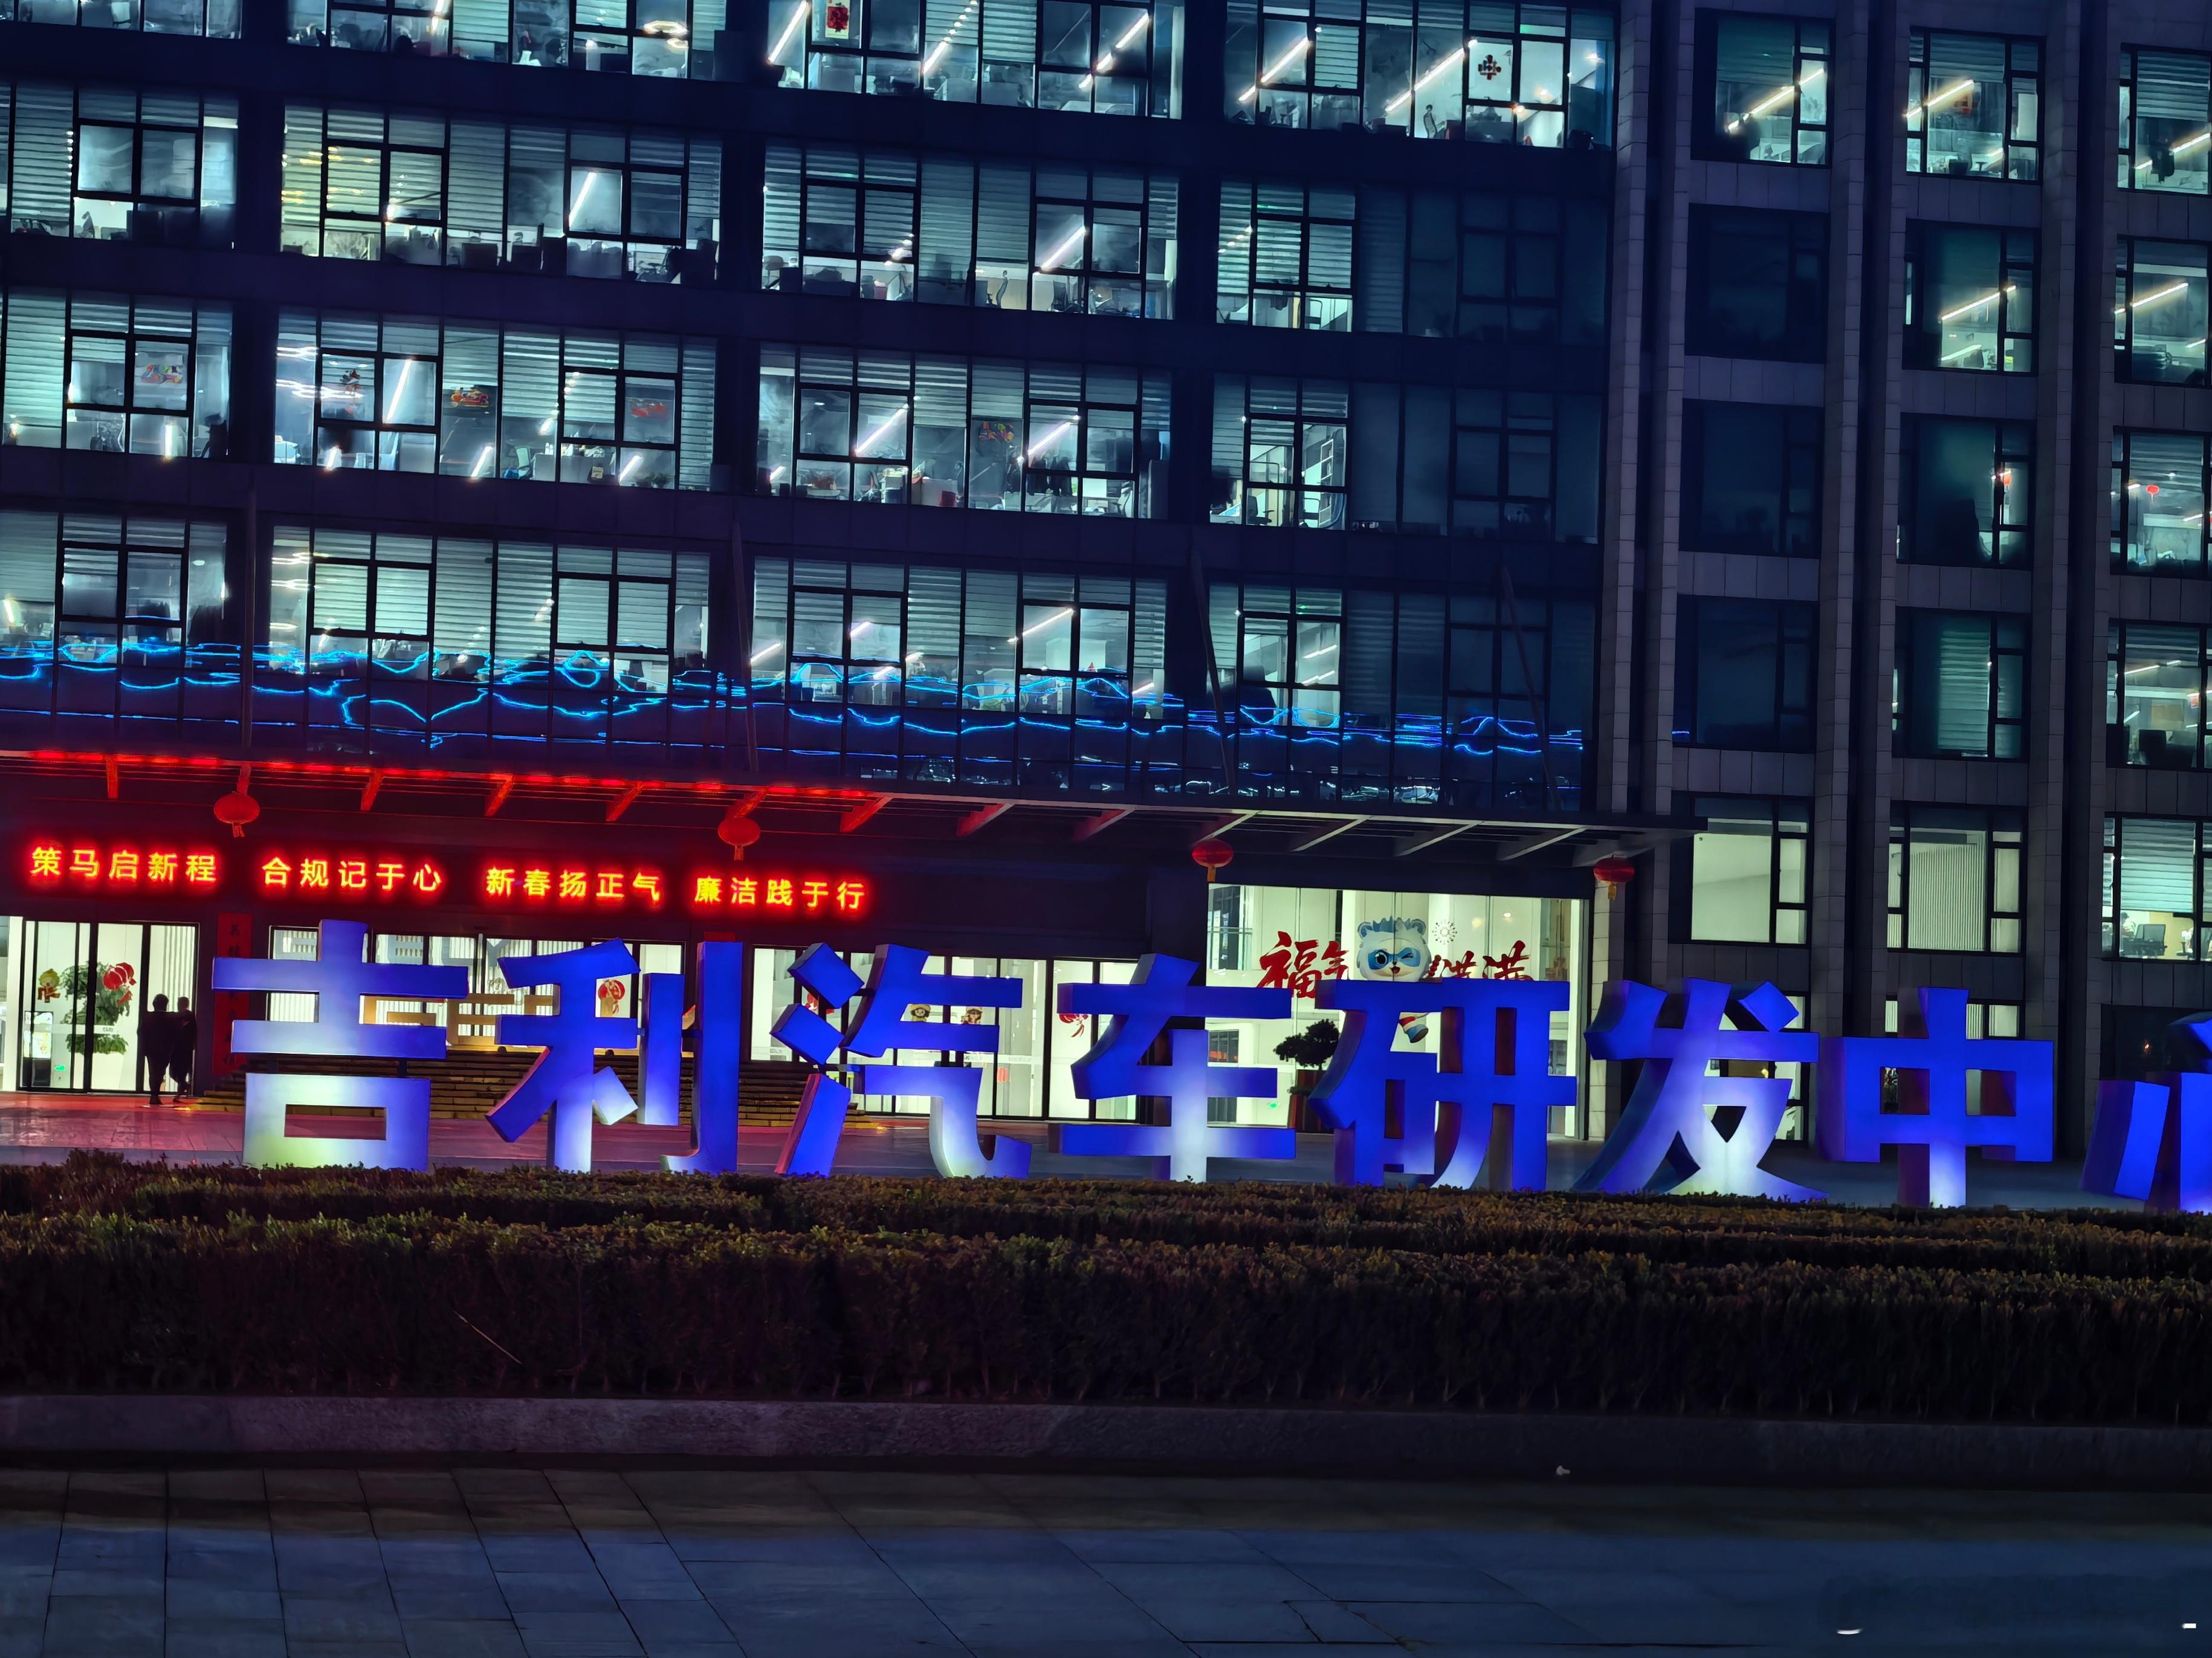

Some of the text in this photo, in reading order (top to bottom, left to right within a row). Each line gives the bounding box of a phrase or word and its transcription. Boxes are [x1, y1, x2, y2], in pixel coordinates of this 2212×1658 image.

[30, 846, 866, 911] 策马启新程 合规记于心 新春扬正气 廉洁践于行
